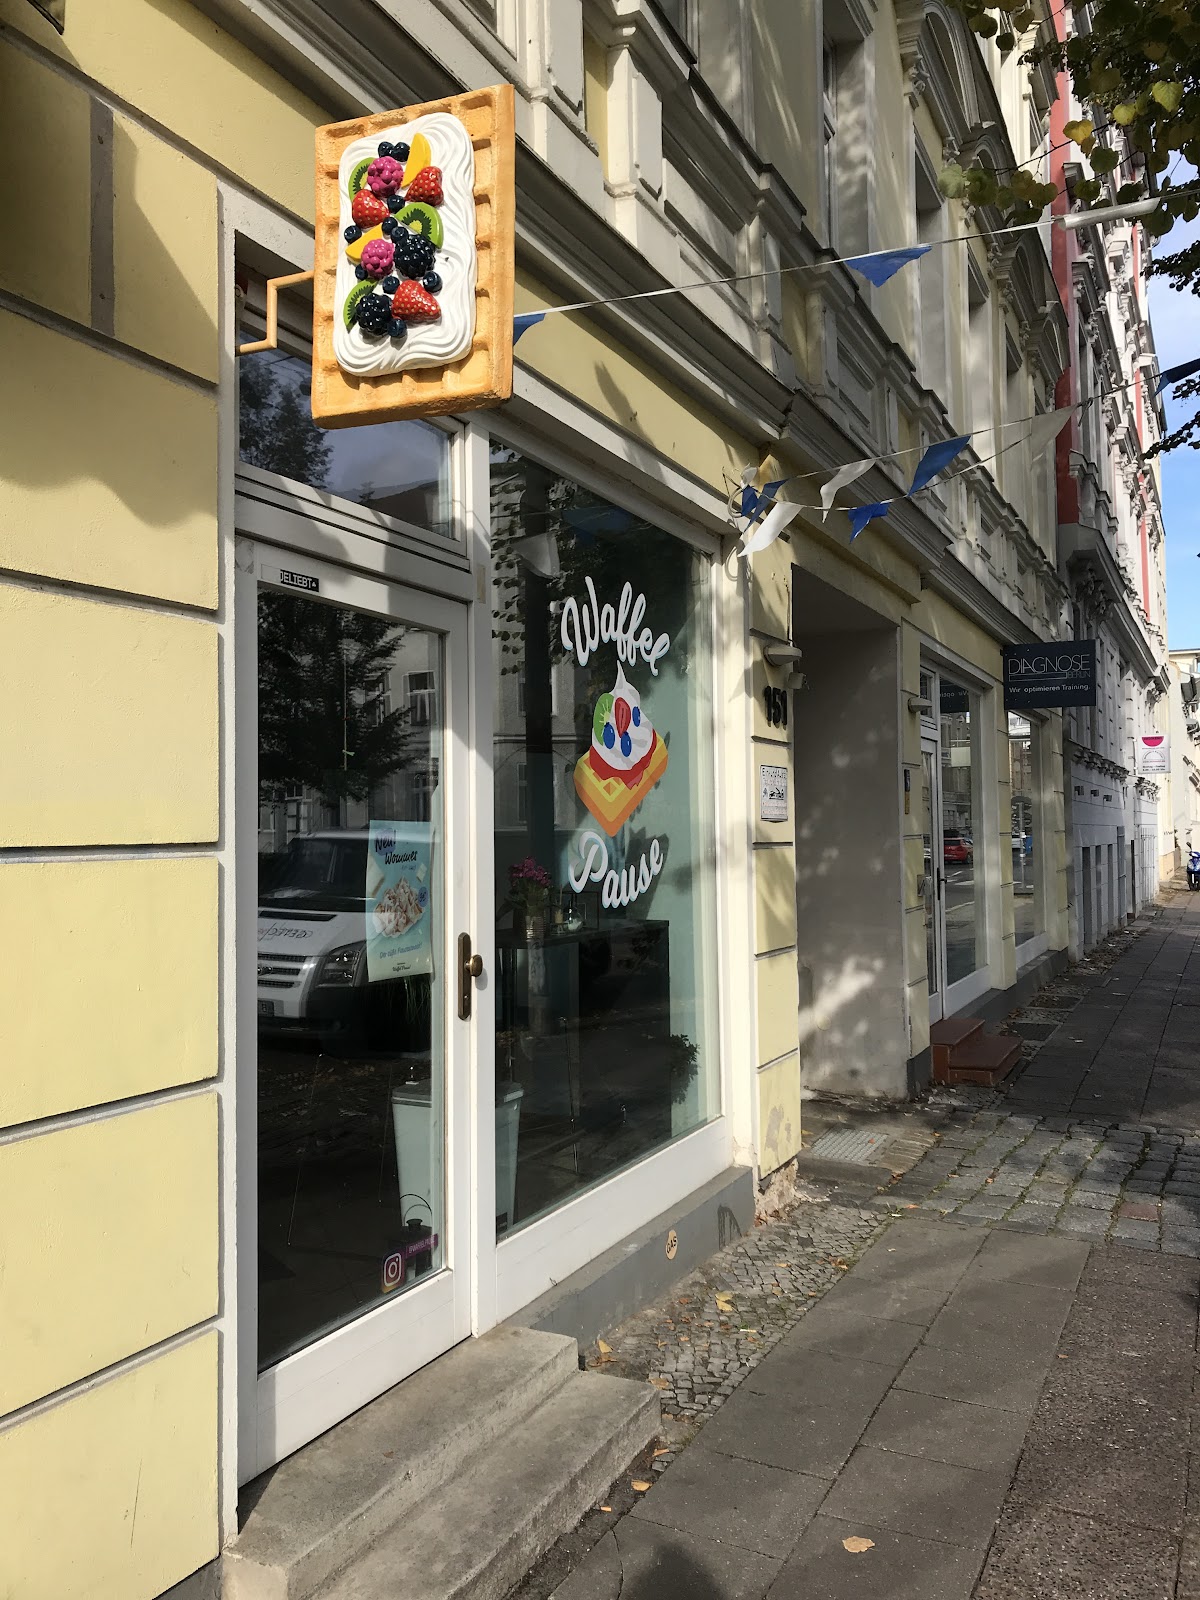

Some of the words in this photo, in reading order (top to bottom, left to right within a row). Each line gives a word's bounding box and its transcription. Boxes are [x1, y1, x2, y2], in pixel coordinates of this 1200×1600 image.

[561, 576, 670, 677] Waffel
[1008, 654, 1091, 675] DIAGNOSE
[1067, 671, 1091, 679] BERLIN
[1024, 685, 1061, 694] optimieren
[1062, 683, 1091, 692] Training.
[763, 686, 788, 726] 151
[375, 829, 397, 853] Neu!
[568, 831, 664, 909] Pause
[666, 1235, 678, 1254] GAS
